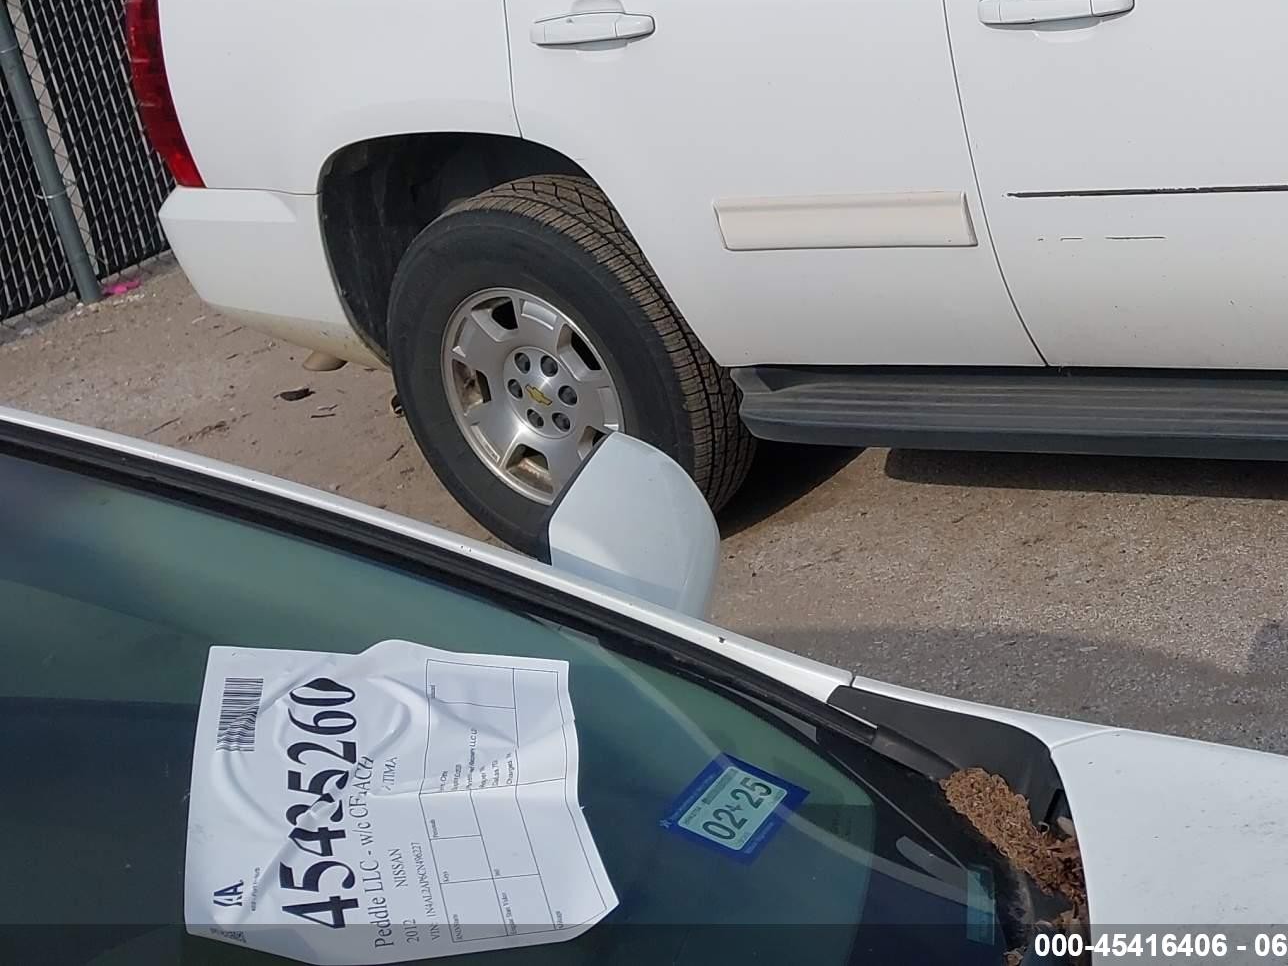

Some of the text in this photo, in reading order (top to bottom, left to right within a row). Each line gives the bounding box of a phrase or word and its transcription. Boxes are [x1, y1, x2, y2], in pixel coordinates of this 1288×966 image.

[352, 821, 374, 846] w/c
[360, 860, 384, 893] LLC
[388, 848, 408, 888] NISSAN
[367, 896, 395, 948] Peddle
[403, 918, 420, 943] 2012
